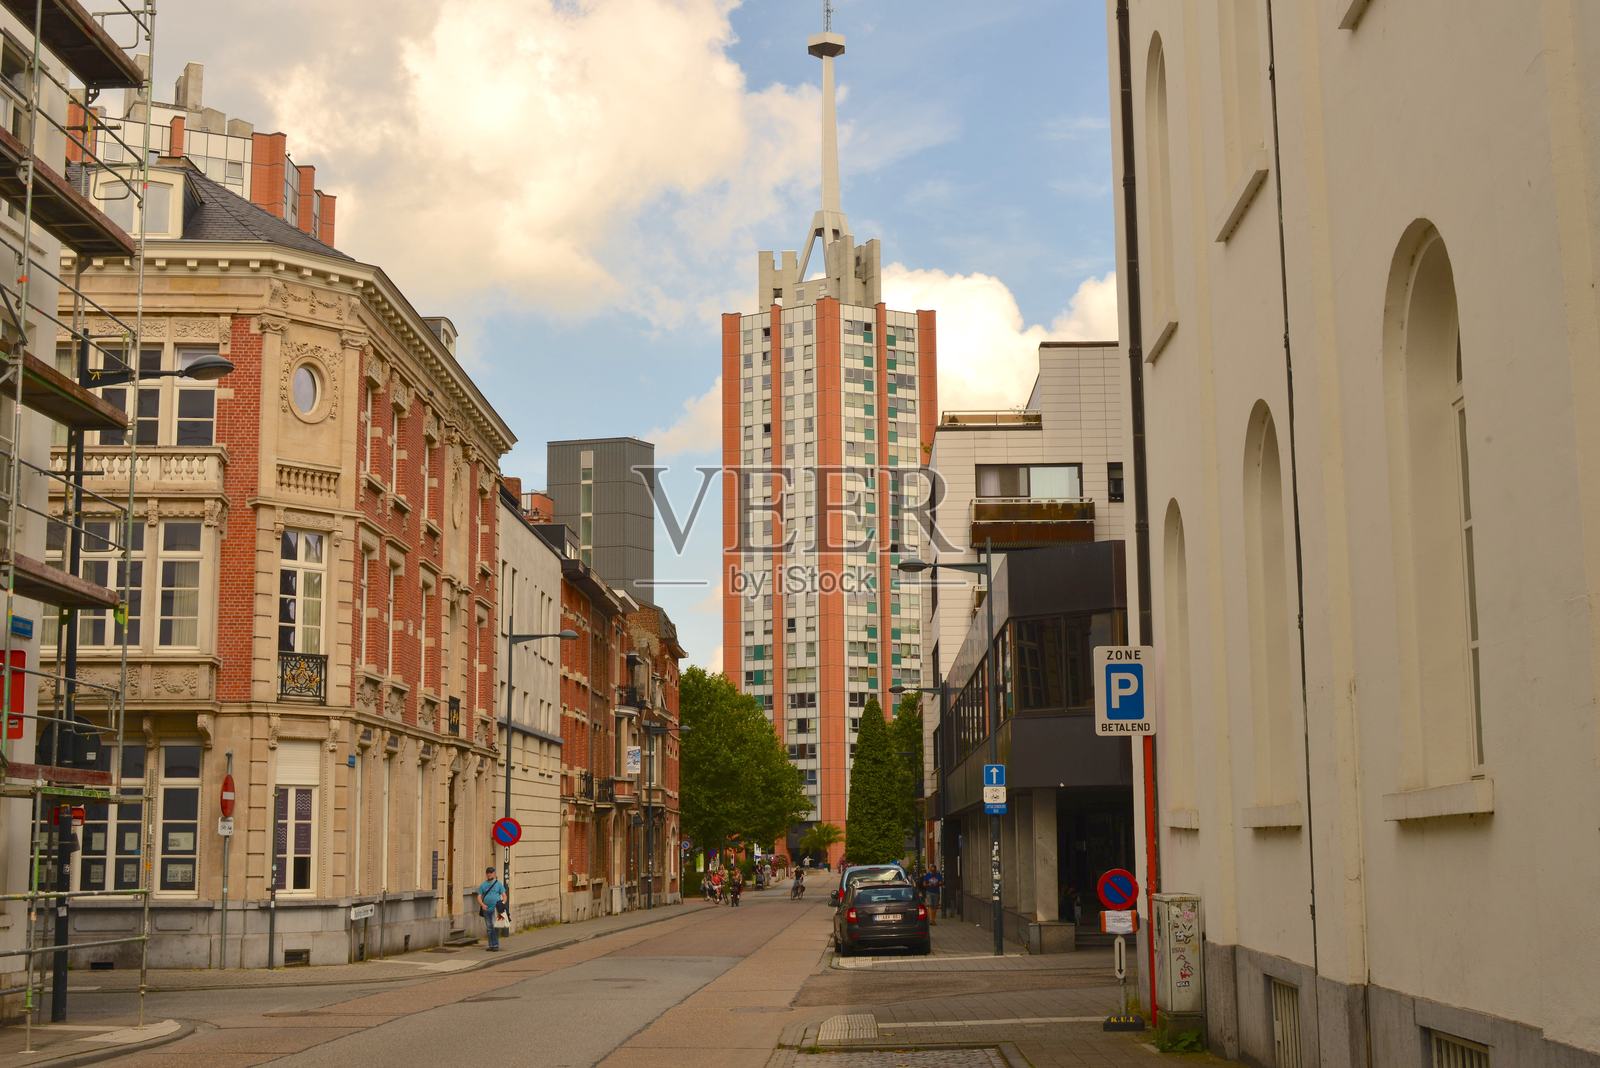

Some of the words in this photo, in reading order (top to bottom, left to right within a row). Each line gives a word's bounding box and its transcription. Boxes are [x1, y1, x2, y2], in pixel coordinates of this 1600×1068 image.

[1106, 650, 1141, 660] ZONE
[1110, 672, 1139, 709] P
[1101, 722, 1151, 732] BETALEND
